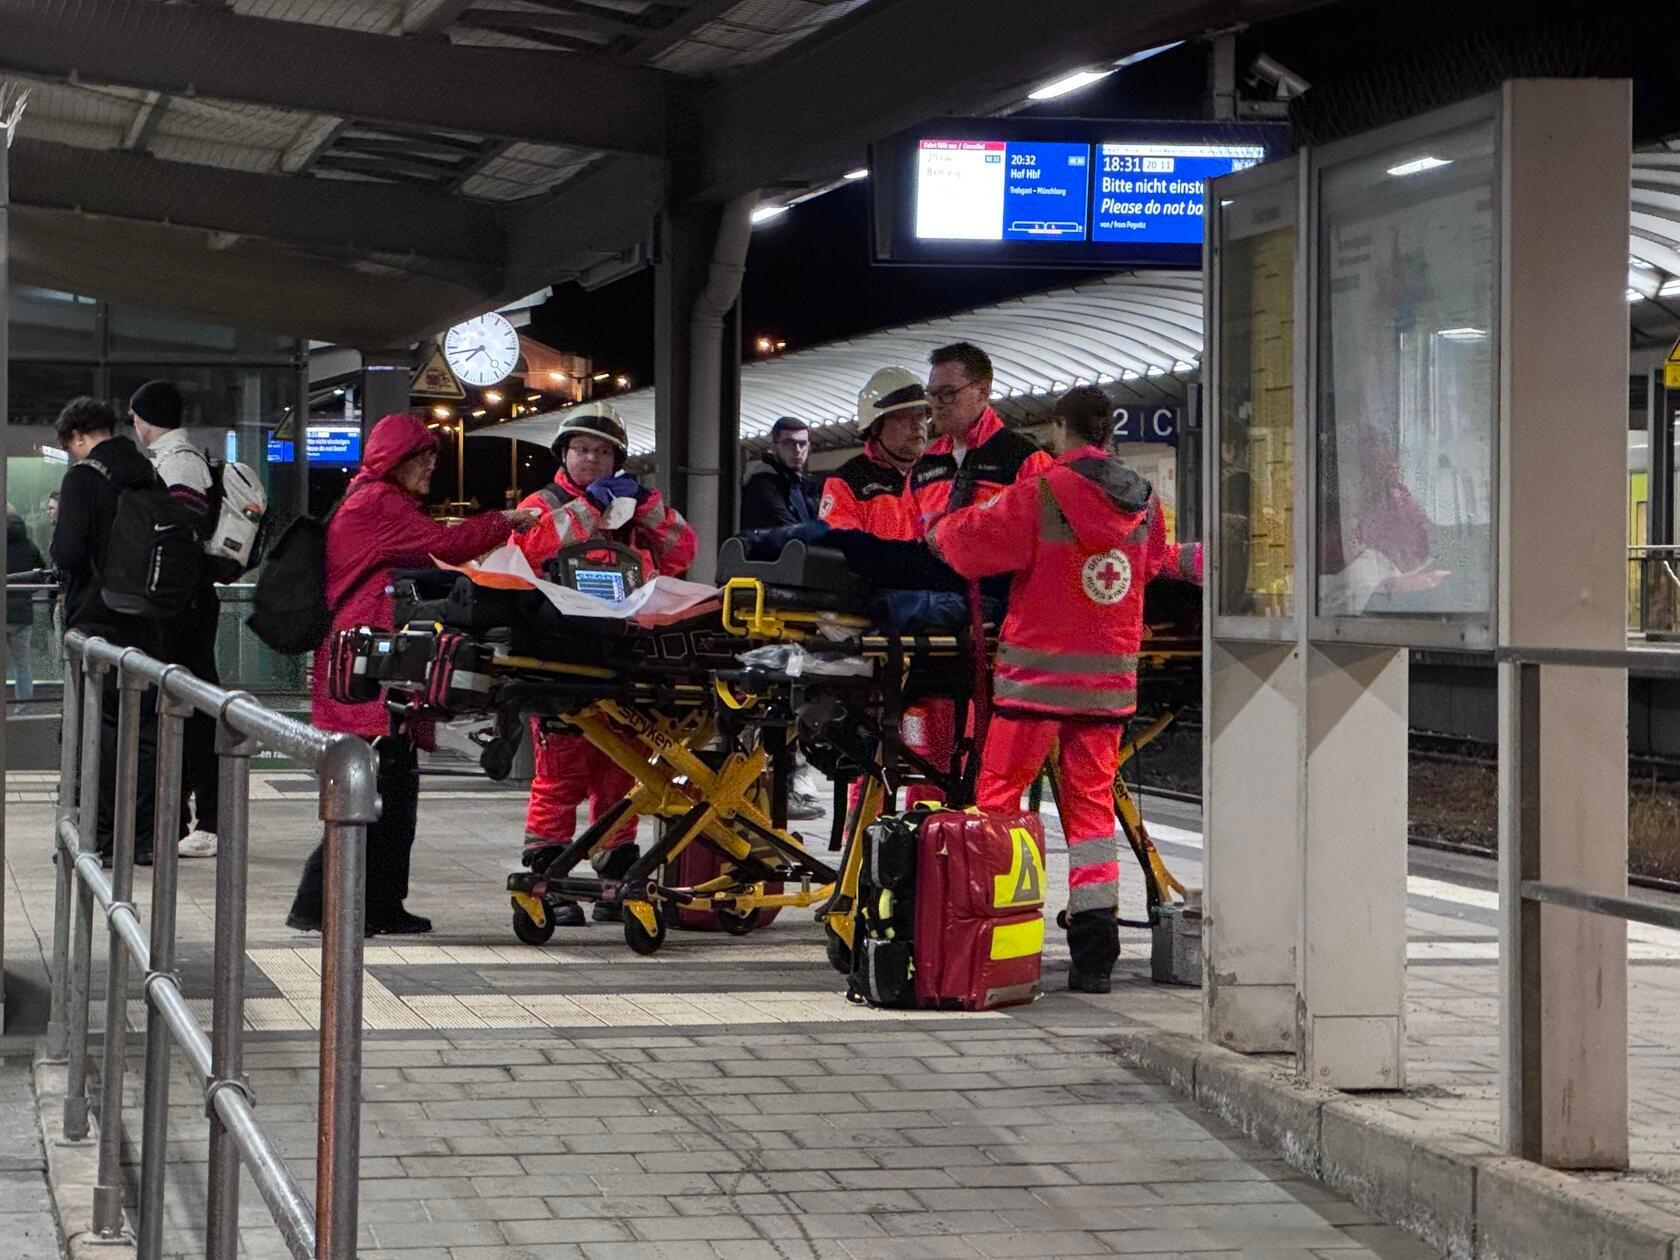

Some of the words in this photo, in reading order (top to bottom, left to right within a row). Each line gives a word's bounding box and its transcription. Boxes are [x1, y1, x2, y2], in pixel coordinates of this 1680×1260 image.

[1011, 154, 1036, 166] 20:32
[1103, 156, 1141, 172] 18:31
[1010, 168, 1025, 179] Hof
[1026, 168, 1041, 179] Hbf
[1102, 177, 1133, 193] Bitte
[1135, 178, 1167, 194] nicht
[1101, 198, 1142, 215] Please
[1145, 199, 1161, 215] do
[1163, 201, 1185, 216] not
[1112, 408, 1129, 435] 2
[1153, 408, 1173, 437] C
[618, 706, 673, 750] stryker
